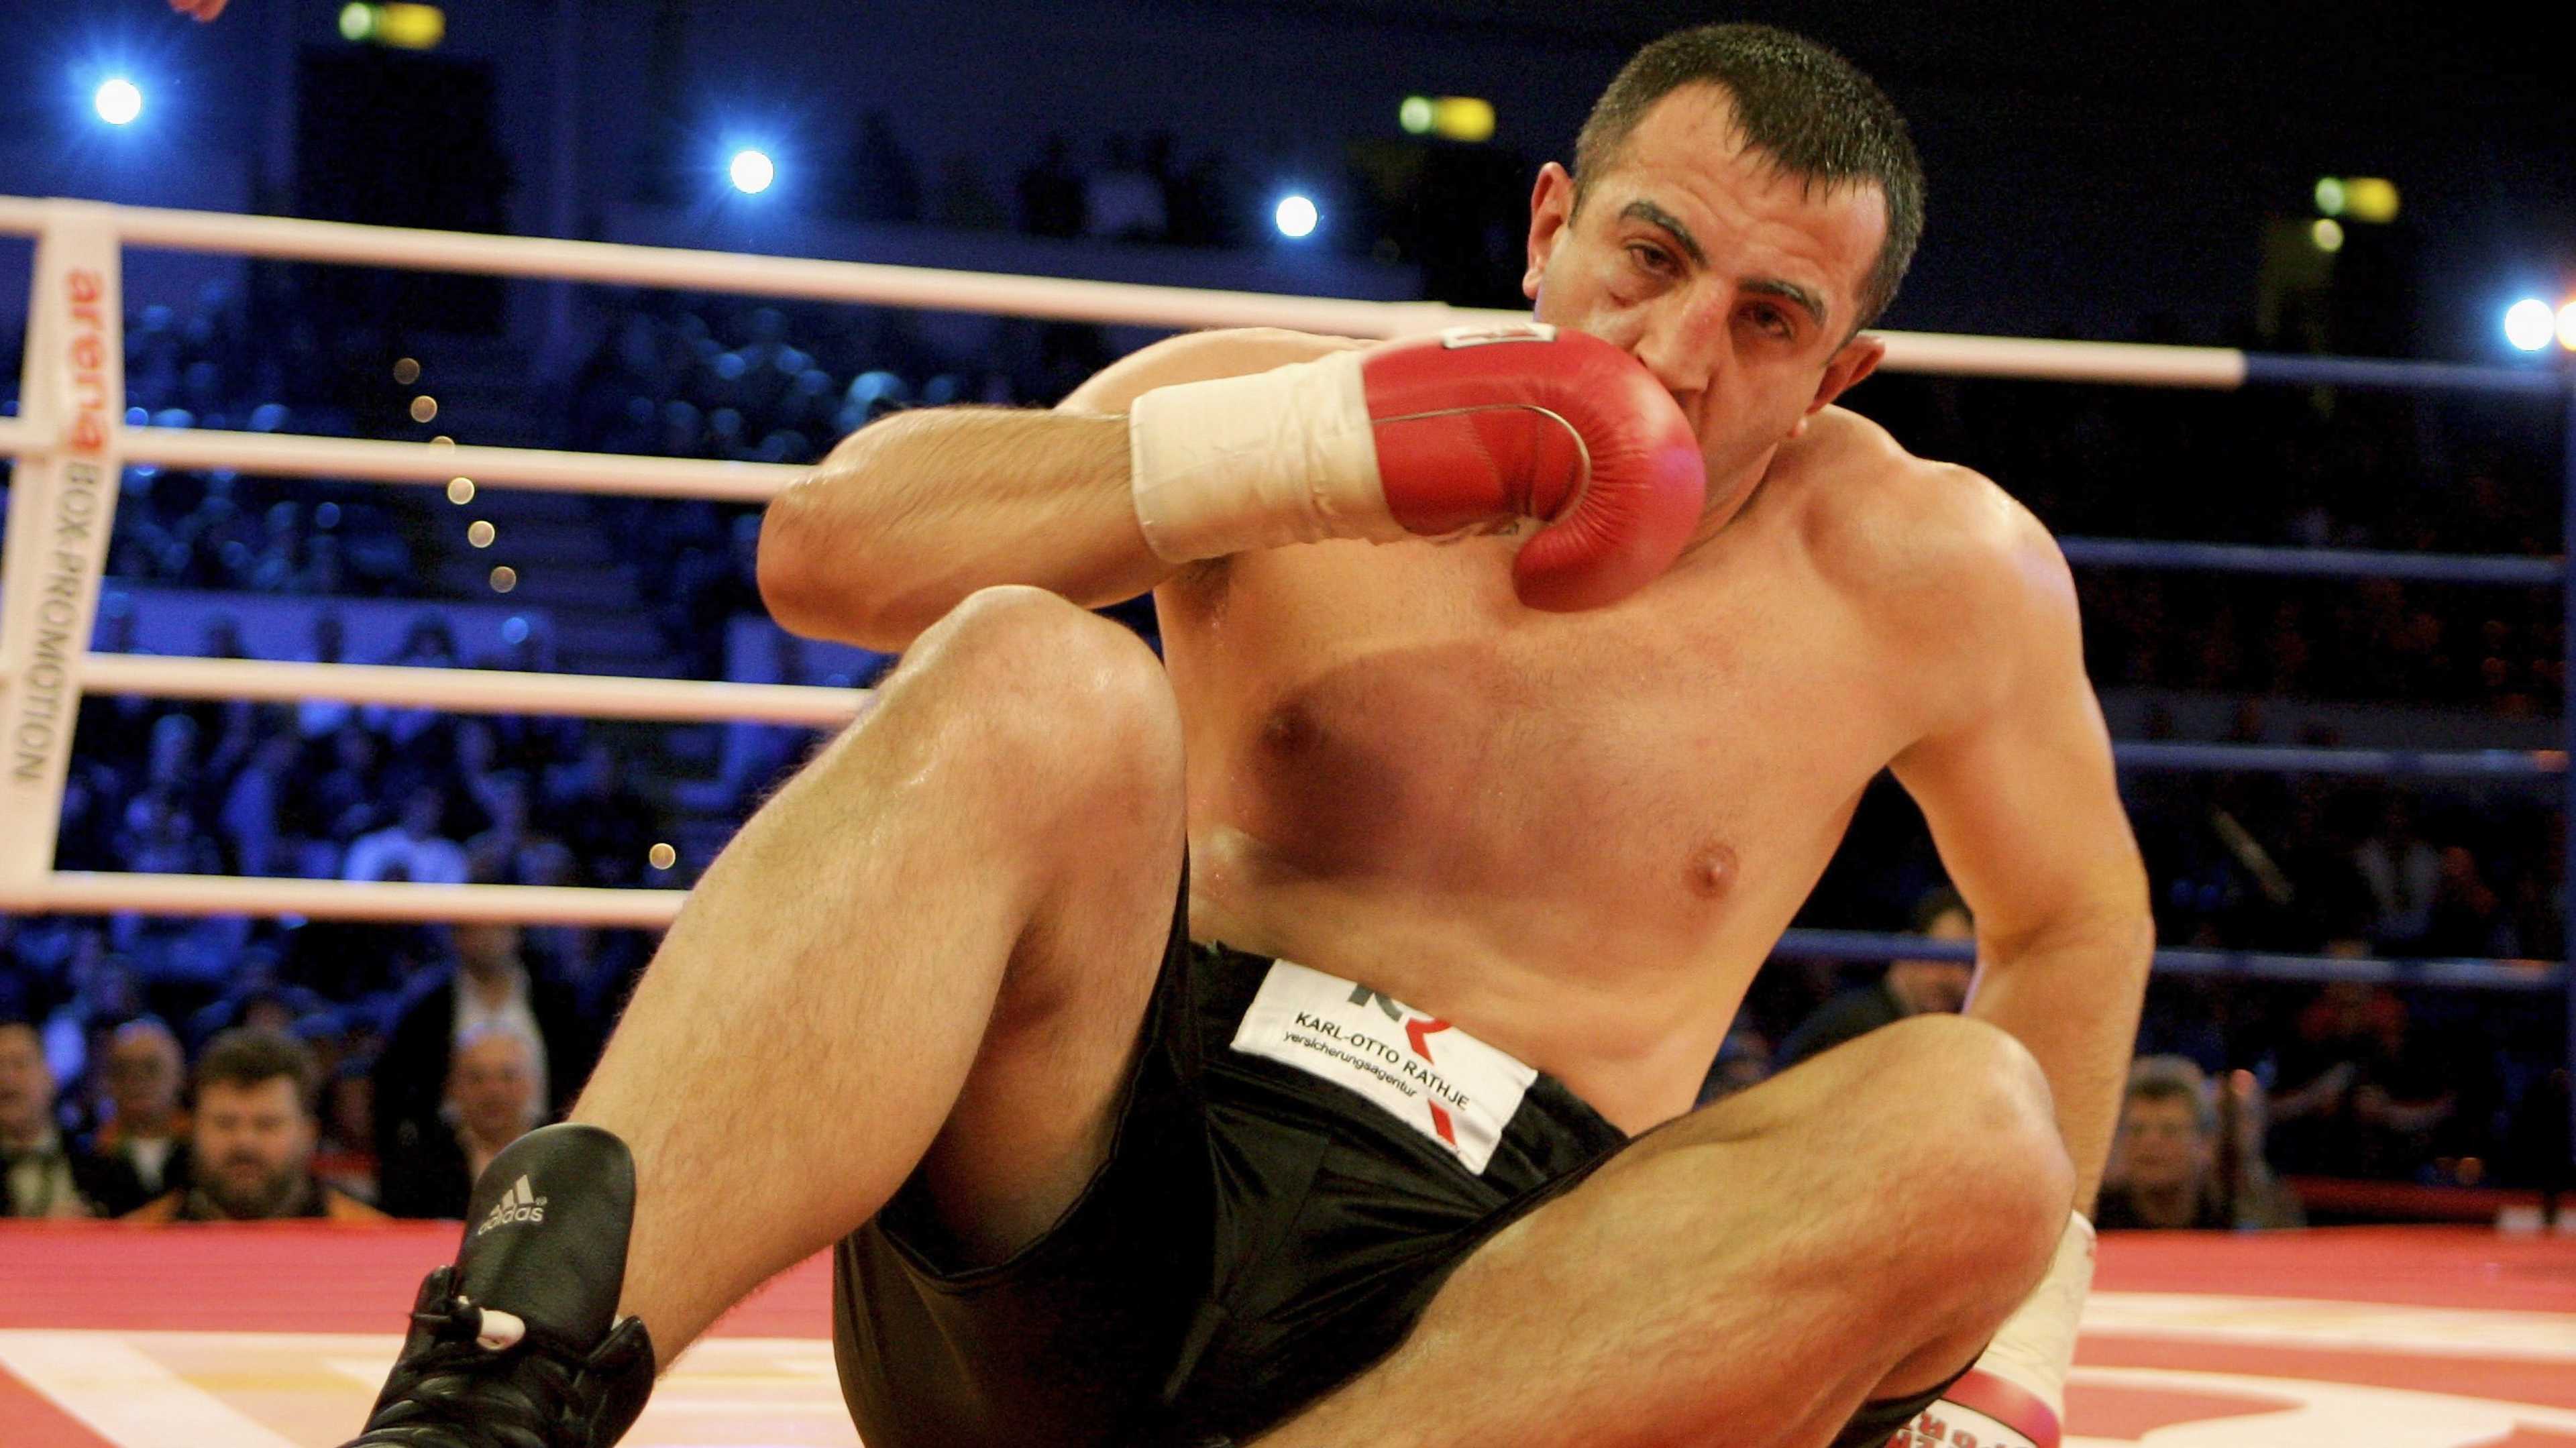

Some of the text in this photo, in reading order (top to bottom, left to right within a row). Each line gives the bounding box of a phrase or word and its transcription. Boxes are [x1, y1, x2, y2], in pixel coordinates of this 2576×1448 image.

[66, 268, 106, 453] arena
[1295, 1011, 1470, 1111] KARL-OTTO RATHJE
[477, 1203, 544, 1235] adidas
